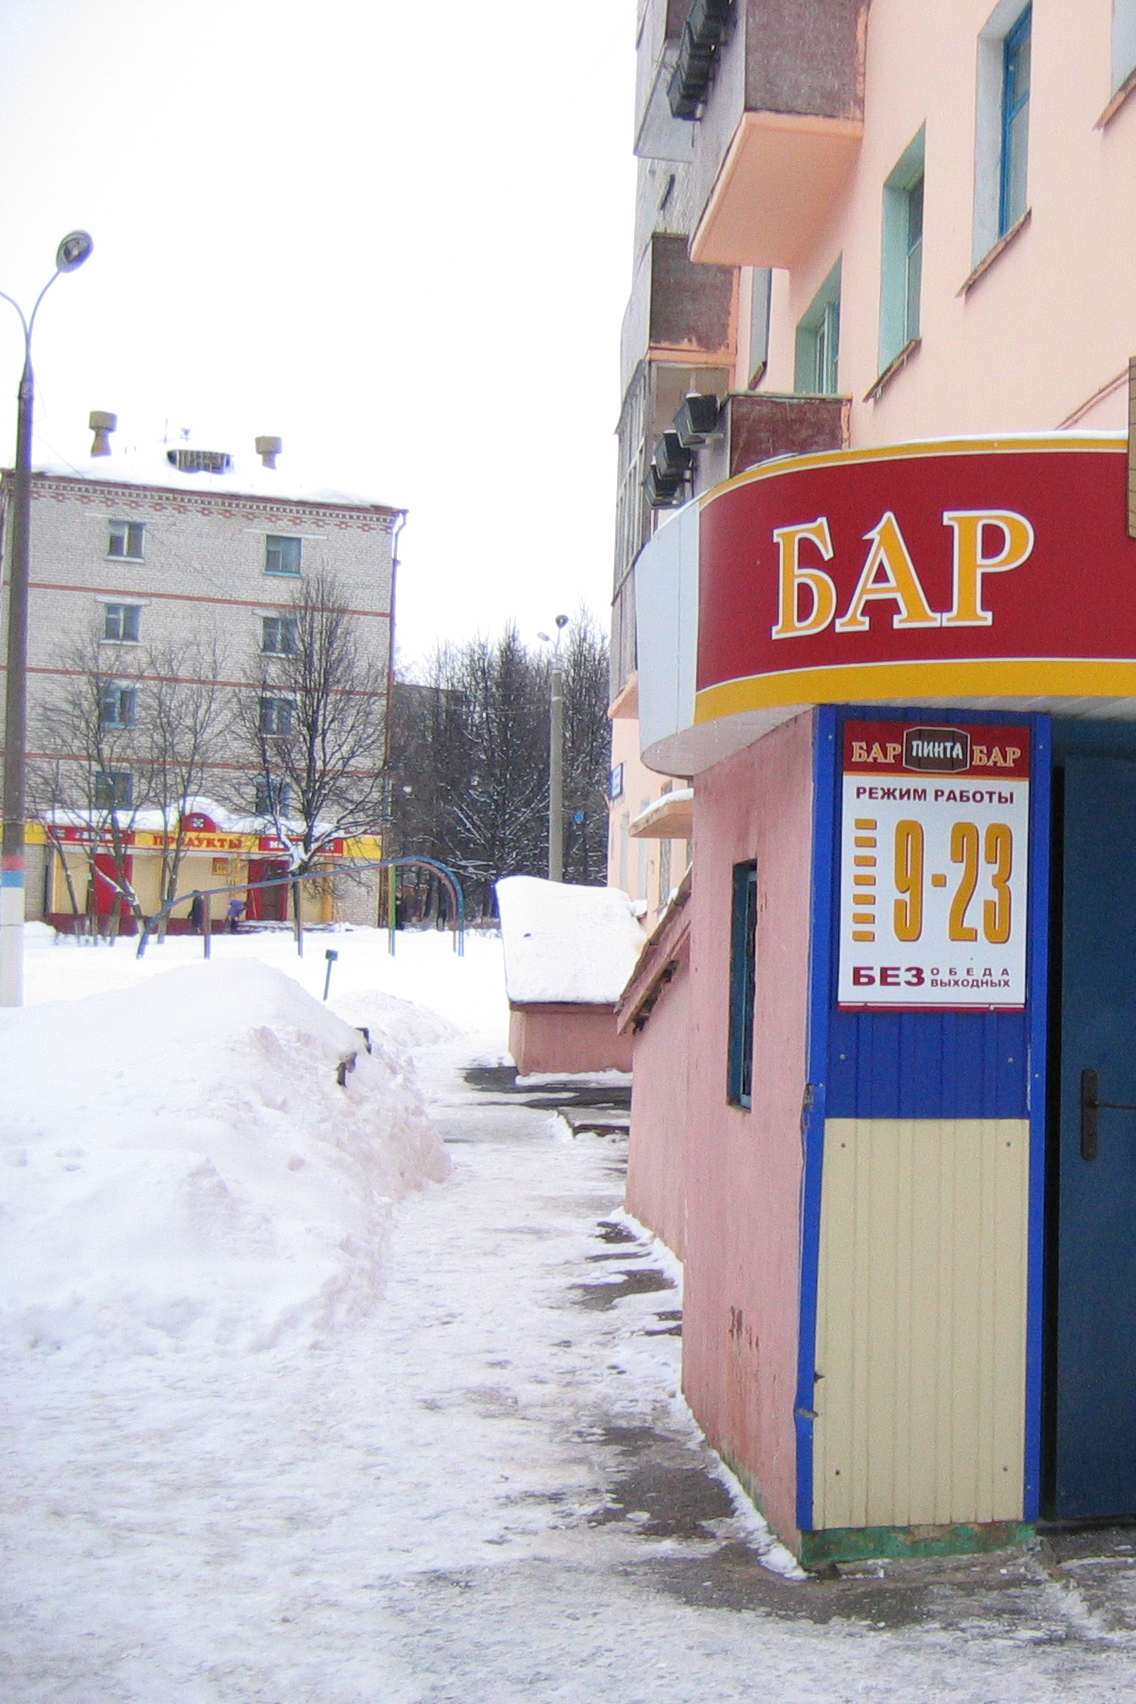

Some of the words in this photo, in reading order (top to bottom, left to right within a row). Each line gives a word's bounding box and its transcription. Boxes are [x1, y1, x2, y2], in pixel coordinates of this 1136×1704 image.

[772, 509, 1035, 640] БАР
[851, 741, 901, 763] БАР
[911, 740, 963, 760] ПИНТА
[972, 745, 1021, 767] БАР
[856, 786, 927, 801] РЕЖИМ
[934, 789, 1014, 804] РАБОТЫ
[153, 834, 242, 849] ПРДУКТЫ
[893, 819, 1013, 944] 9-23
[852, 966, 925, 987] БЕЗ
[930, 978, 1010, 989] ВЫХОДНЫХ
